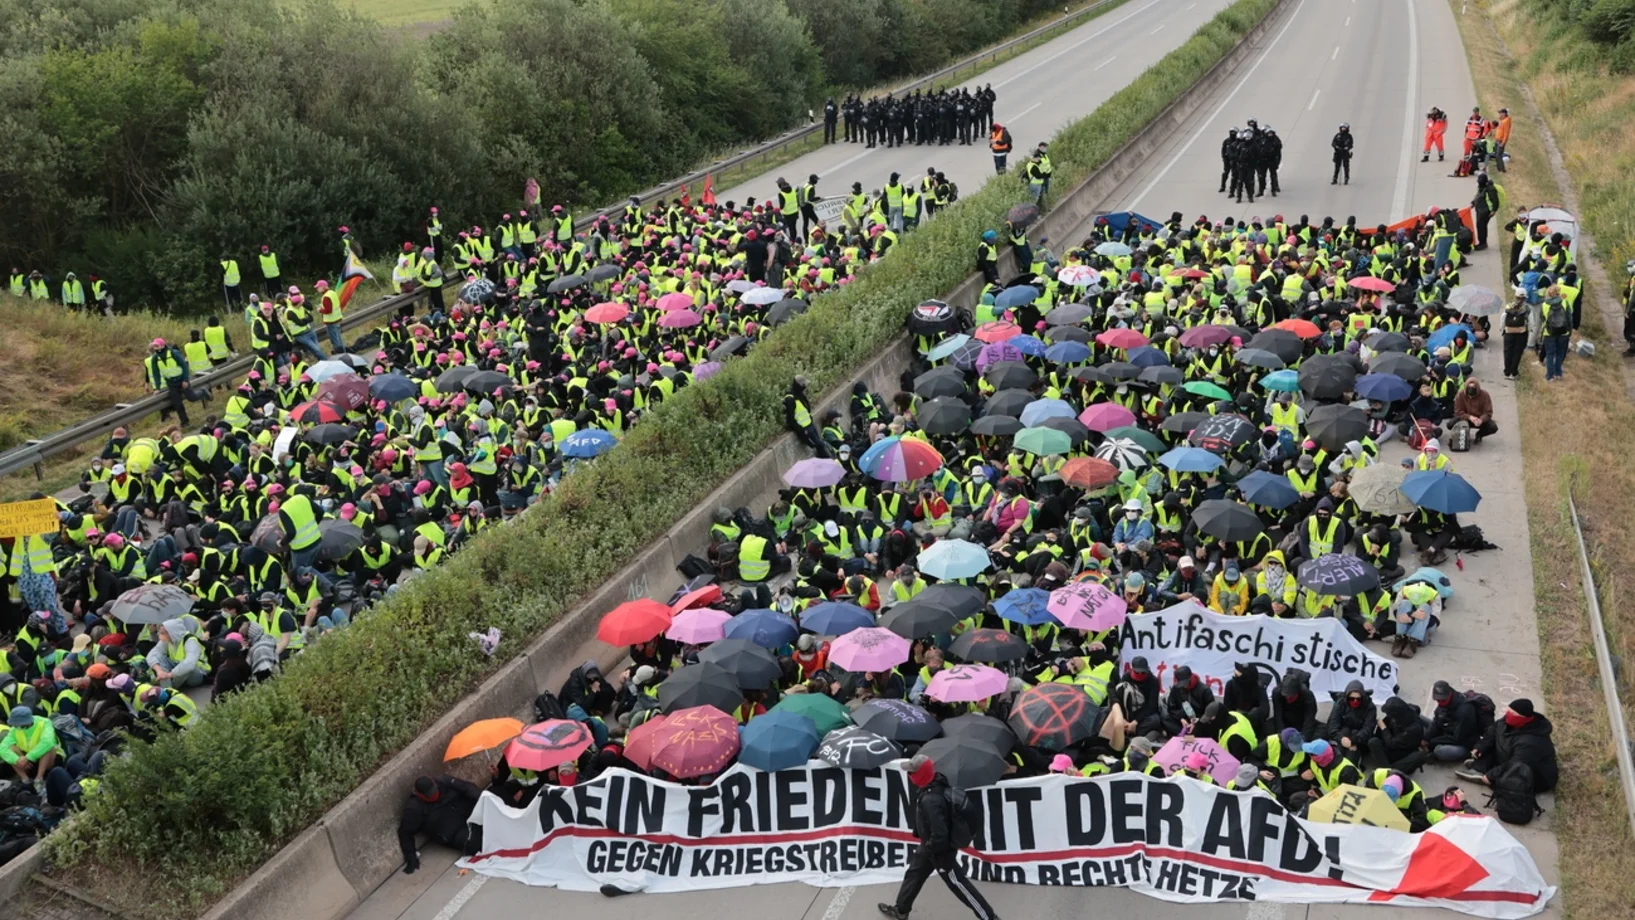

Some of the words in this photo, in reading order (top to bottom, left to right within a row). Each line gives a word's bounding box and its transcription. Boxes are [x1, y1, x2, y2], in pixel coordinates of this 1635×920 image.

[538, 775, 666, 835] KEIN
[687, 767, 917, 838] FRIEDEN
[1066, 779, 1185, 847] DER
[1201, 792, 1344, 881] AFD!
[587, 840, 683, 877] GEGEN
[1155, 860, 1259, 901] HETZE
